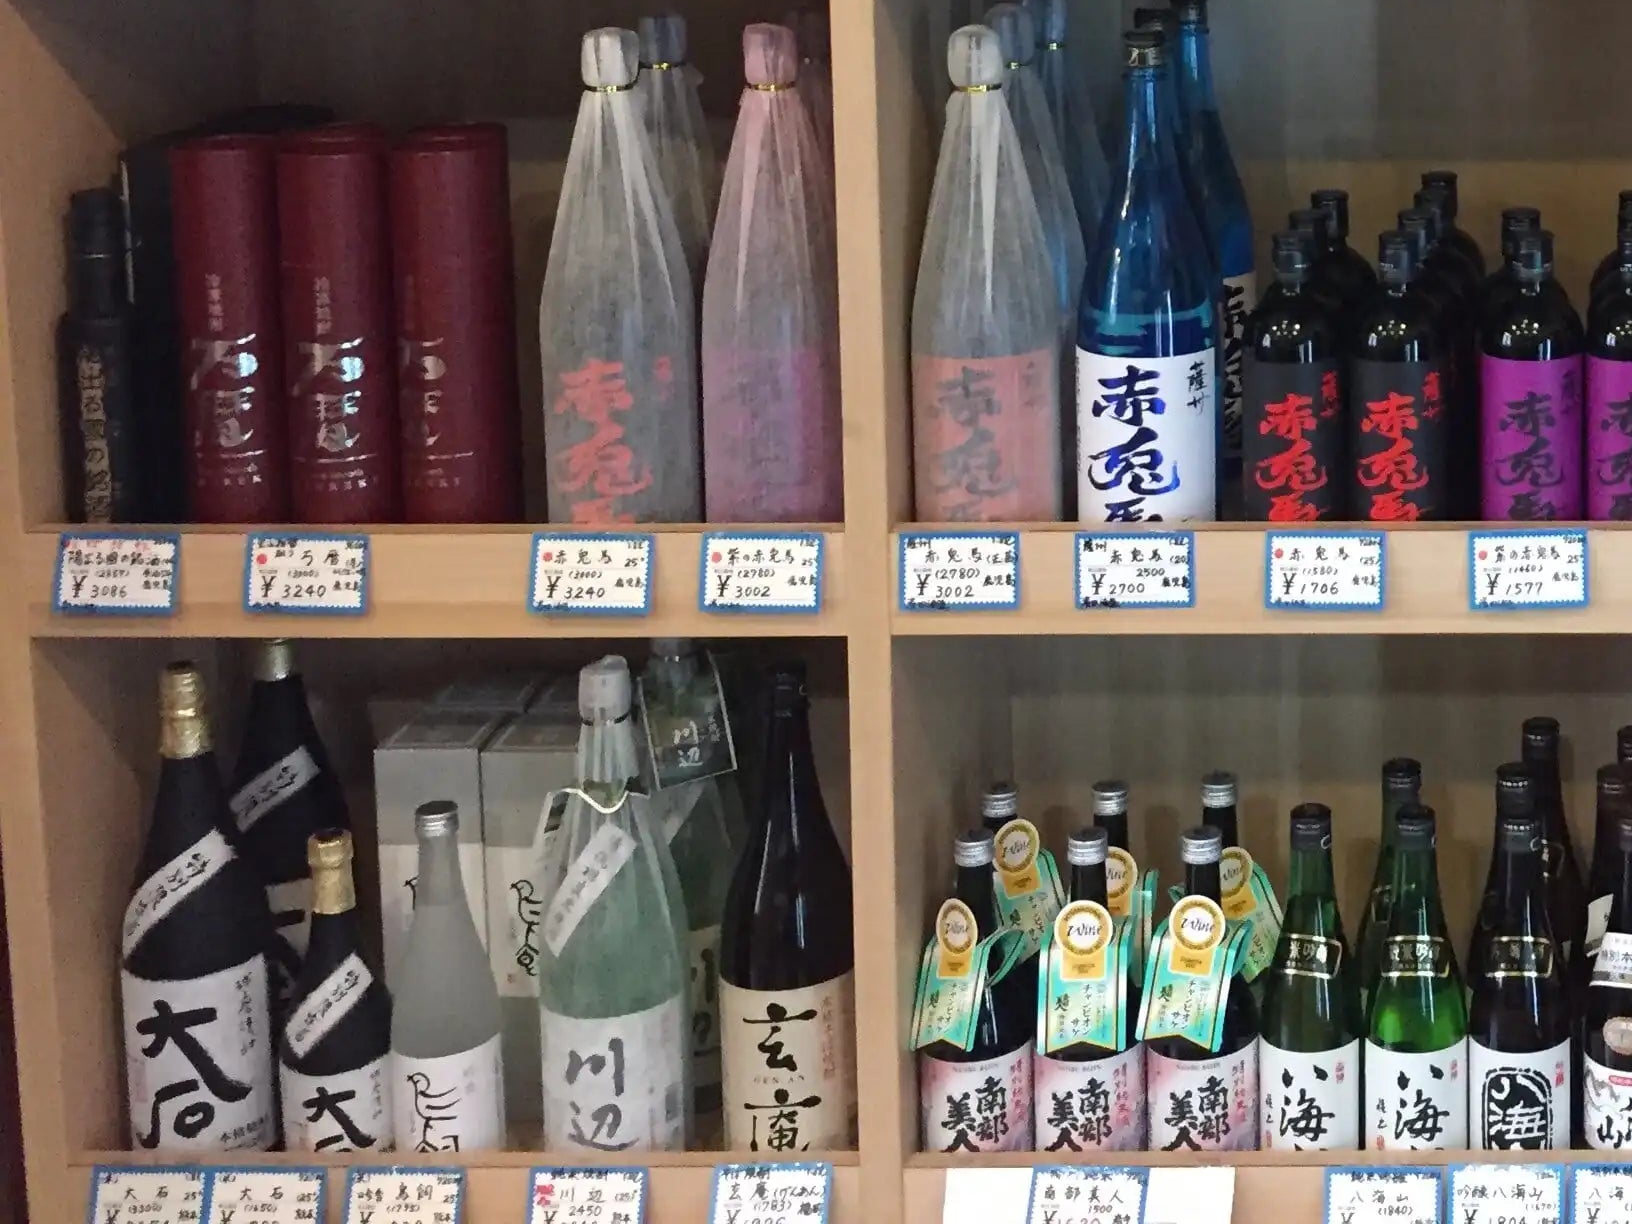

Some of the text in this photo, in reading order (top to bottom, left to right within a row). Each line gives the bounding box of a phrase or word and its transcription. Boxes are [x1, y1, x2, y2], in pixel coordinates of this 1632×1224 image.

[1136, 568, 1165, 576] 2500
[136, 998, 253, 1149] 大石
[566, 1038, 640, 1151] 川辺
[1279, 1064, 1336, 1150] 八海
[1394, 1064, 1450, 1150] 八海
[125, 1186, 168, 1200] 大石
[240, 1186, 283, 1201] 大石
[1045, 1185, 1123, 1202] 南部美人
[1351, 1191, 1408, 1204] 八海山
